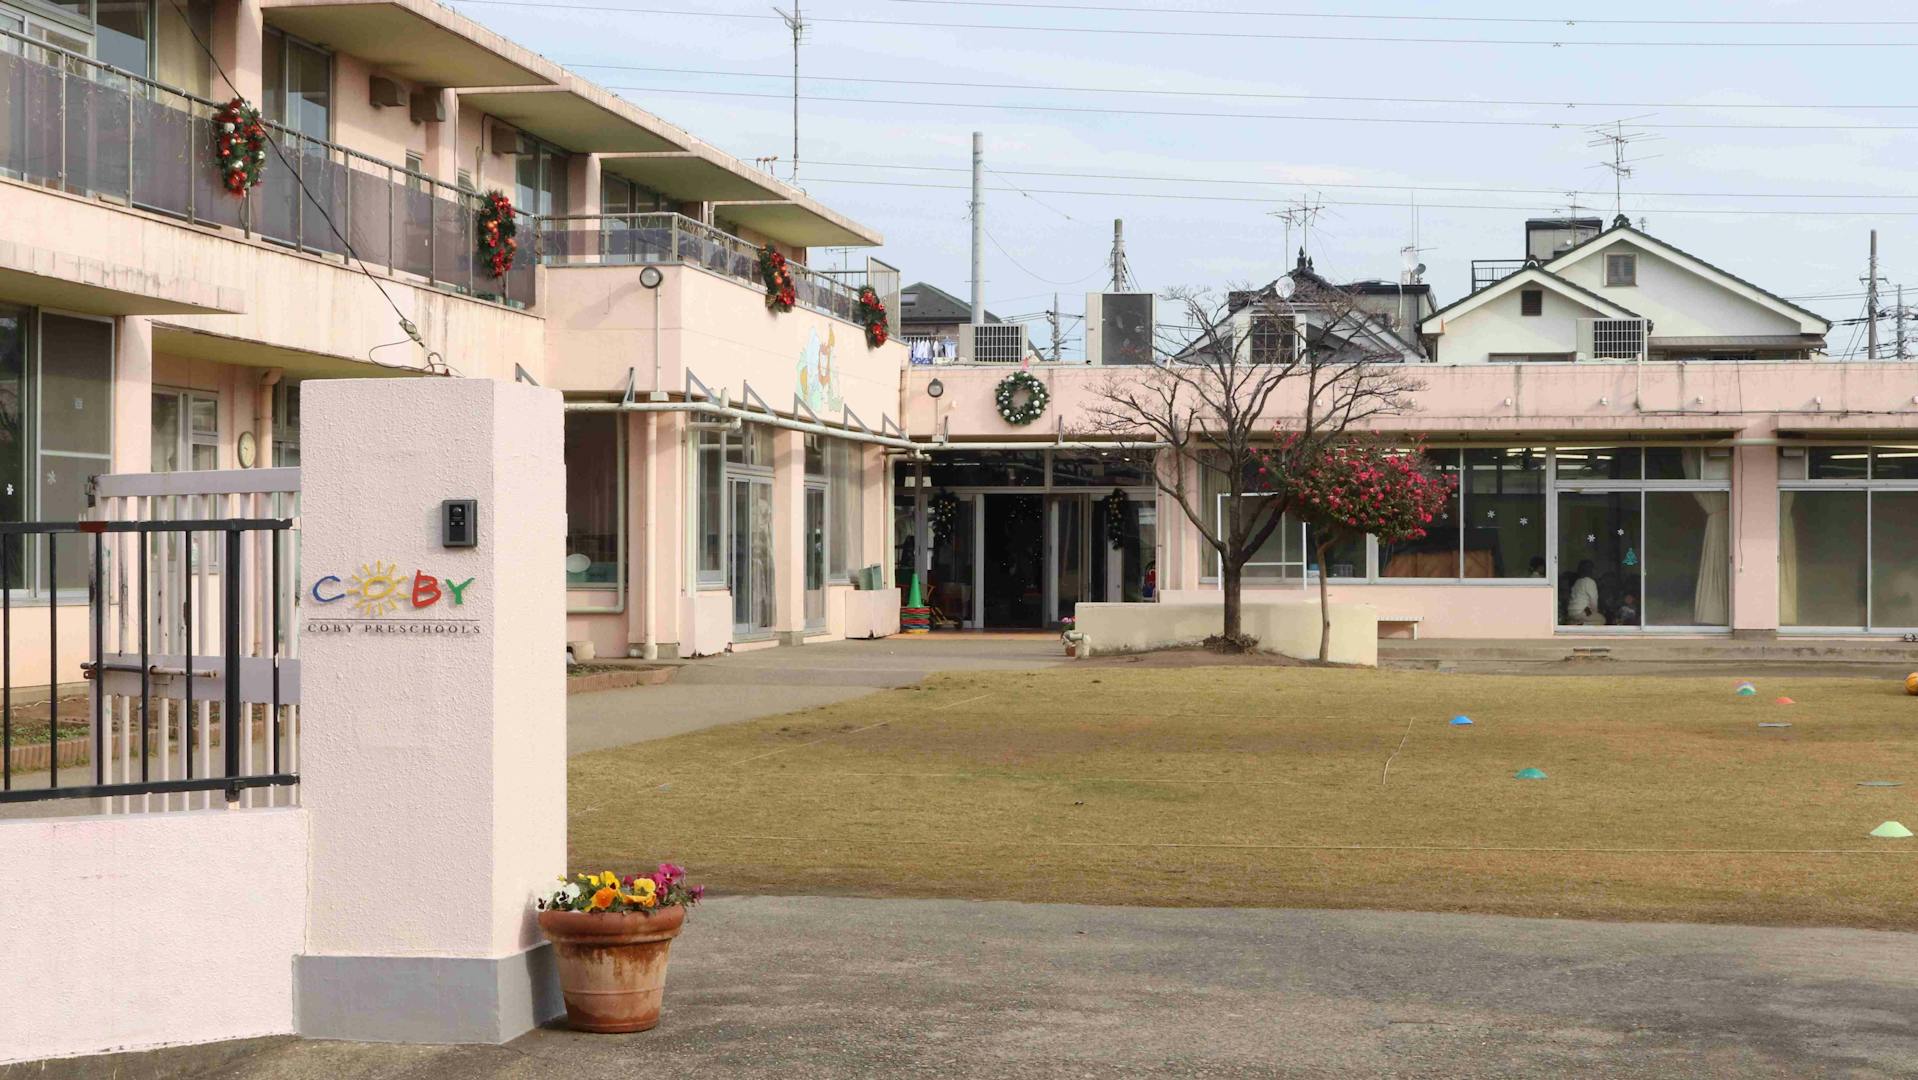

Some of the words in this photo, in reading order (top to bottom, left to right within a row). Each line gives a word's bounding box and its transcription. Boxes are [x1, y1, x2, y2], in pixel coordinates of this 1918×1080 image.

[312, 562, 475, 614] COBY
[307, 624, 354, 635] COBY
[364, 624, 481, 635] PRESCHOOLS
